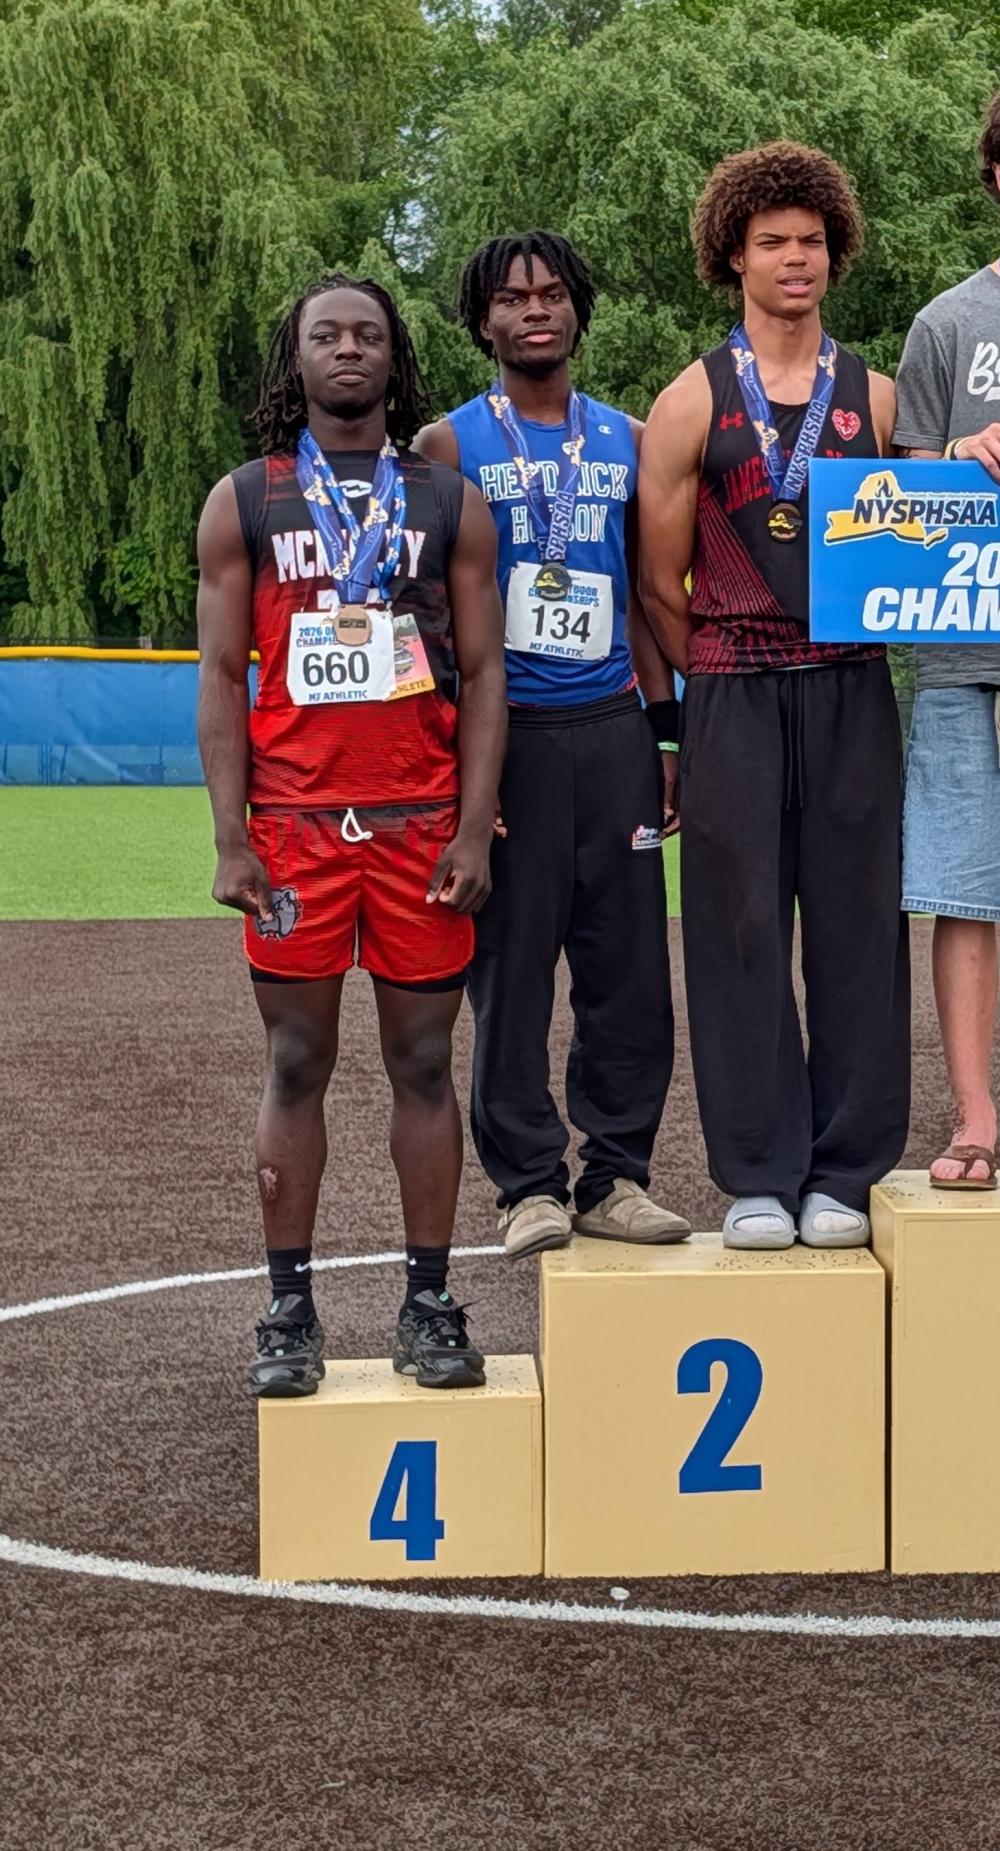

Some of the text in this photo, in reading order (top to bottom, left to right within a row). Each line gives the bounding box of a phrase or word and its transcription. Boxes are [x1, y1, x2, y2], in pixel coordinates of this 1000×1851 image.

[783, 399, 828, 493] NYSPHSAA
[480, 461, 628, 502] HEDICK
[511, 503, 607, 544] HON
[852, 498, 997, 526] NYSPHSAA
[531, 605, 591, 643] 134
[302, 651, 370, 687] 660
[676, 1337, 763, 1494] 2
[369, 1440, 445, 1561] 4
